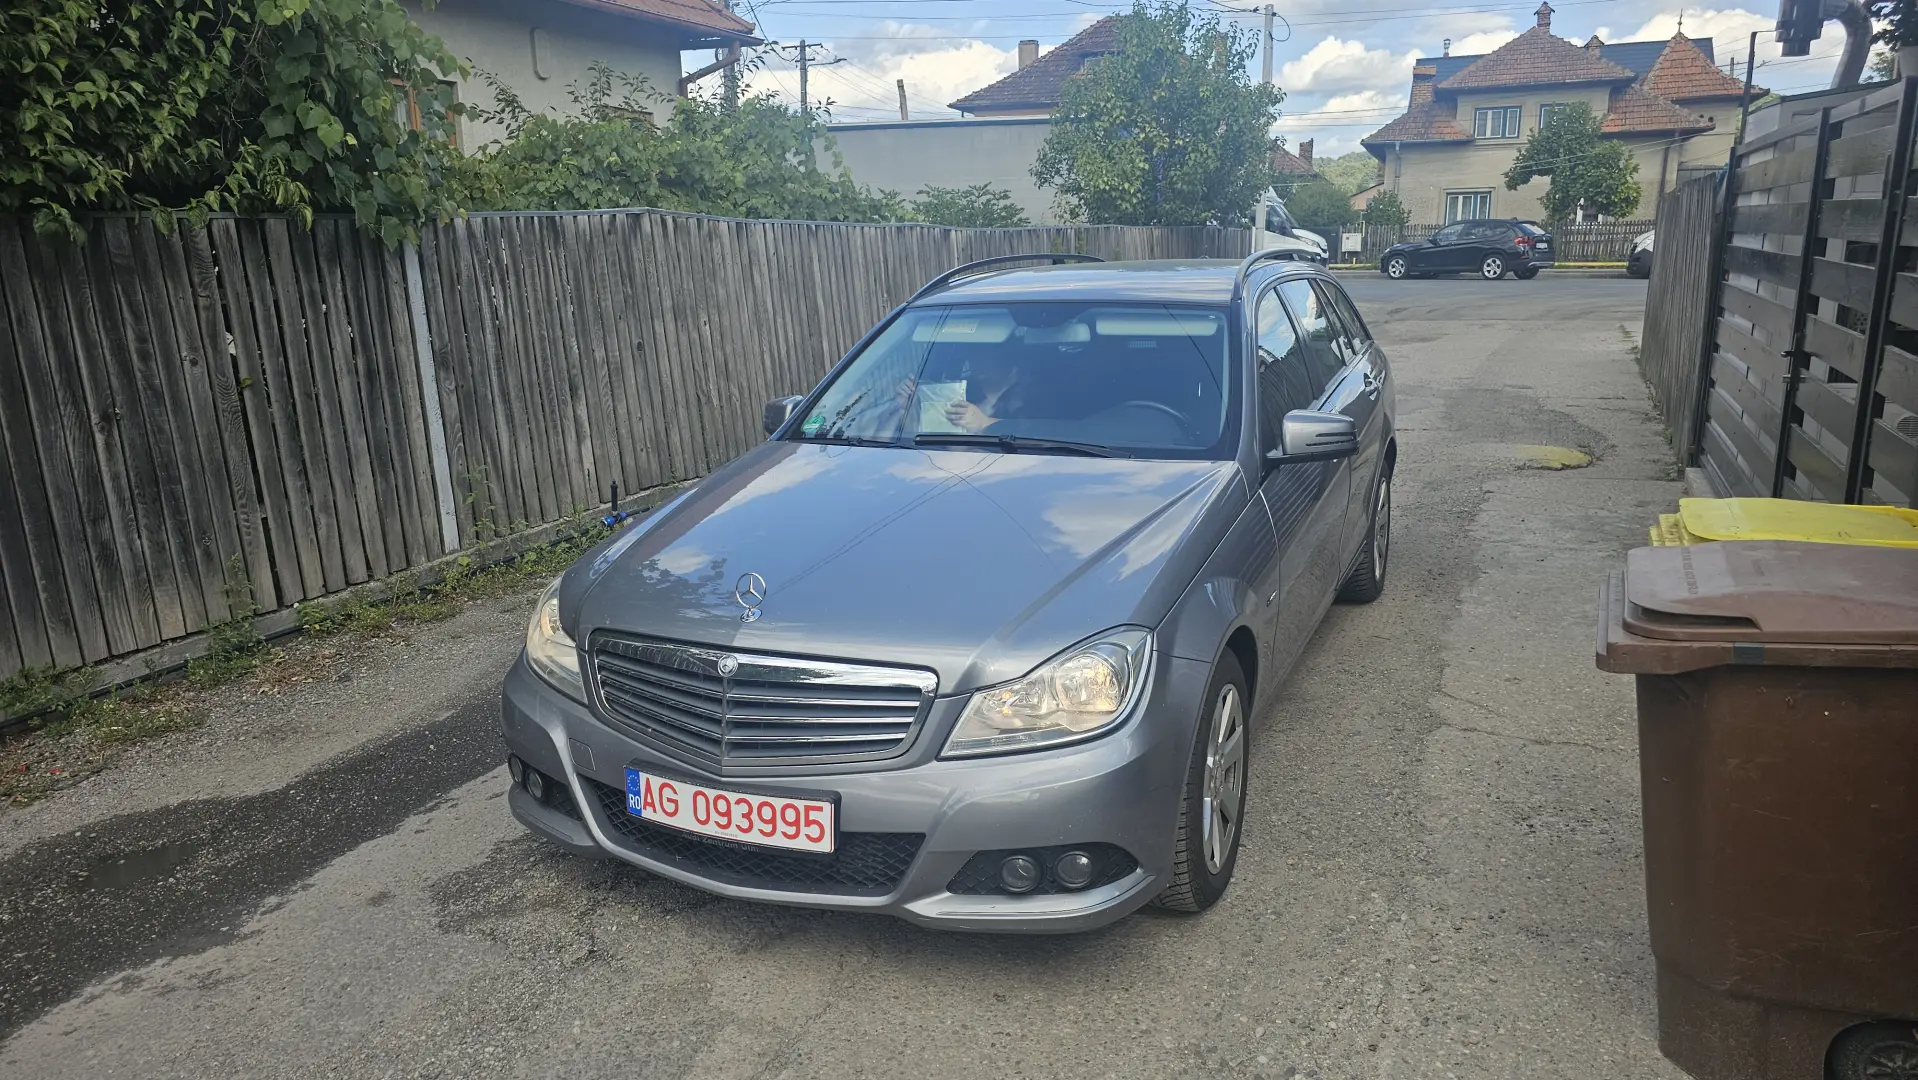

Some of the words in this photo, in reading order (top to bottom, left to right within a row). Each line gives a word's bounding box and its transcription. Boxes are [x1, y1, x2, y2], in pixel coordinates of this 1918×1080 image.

[629, 794, 641, 809] RO
[643, 777, 679, 817] AG
[693, 790, 825, 843] 093995
[702, 836, 738, 849] Zentrum
